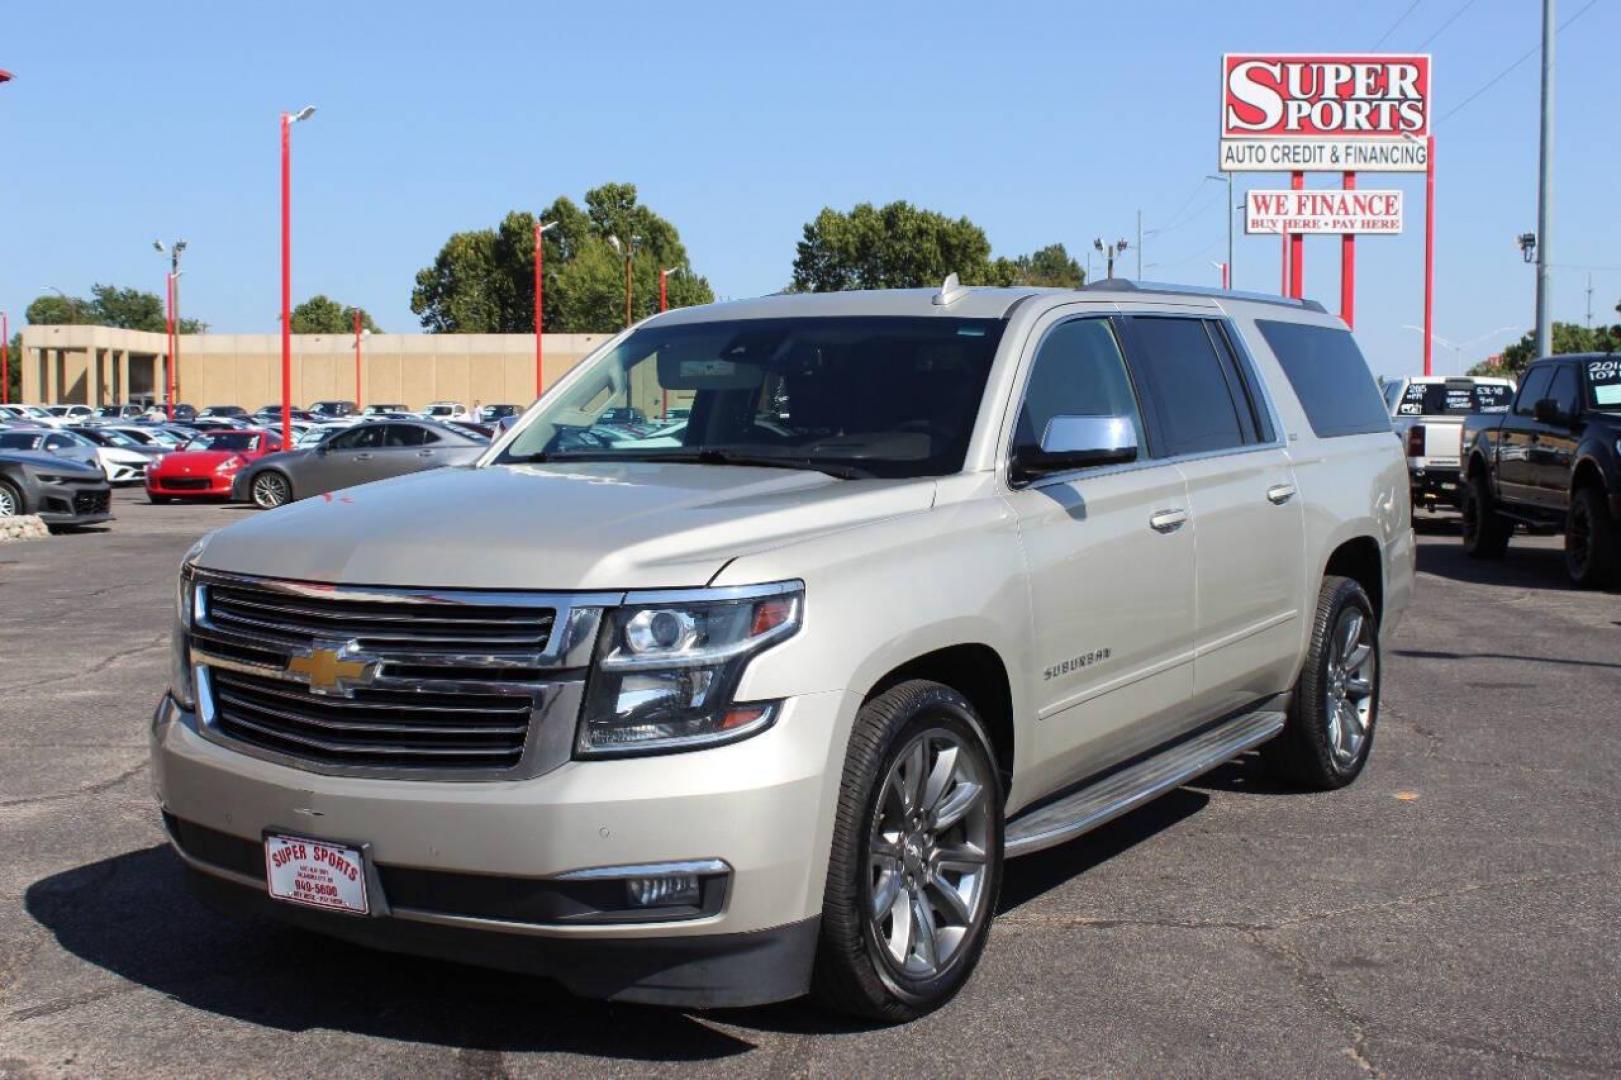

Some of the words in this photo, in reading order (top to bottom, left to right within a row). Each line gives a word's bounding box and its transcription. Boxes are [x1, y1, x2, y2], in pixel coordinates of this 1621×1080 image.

[1229, 61, 1422, 130] SUPER
[1225, 145, 1266, 164] AUTO
[1270, 145, 1325, 164] CREDIT
[1330, 145, 1340, 164] &
[1345, 145, 1426, 165] FINANCING
[1252, 194, 1288, 216] WE
[1296, 194, 1398, 216] FINANCE
[1251, 219, 1278, 229] BUY
[1283, 219, 1320, 229] HERE
[1332, 219, 1357, 229] PAY
[1361, 219, 1399, 229] HERE
[1588, 361, 1621, 371] 201
[1043, 648, 1111, 681] SUBURBAN
[272, 844, 307, 868] SUPER
[313, 846, 358, 881] SPORTS
